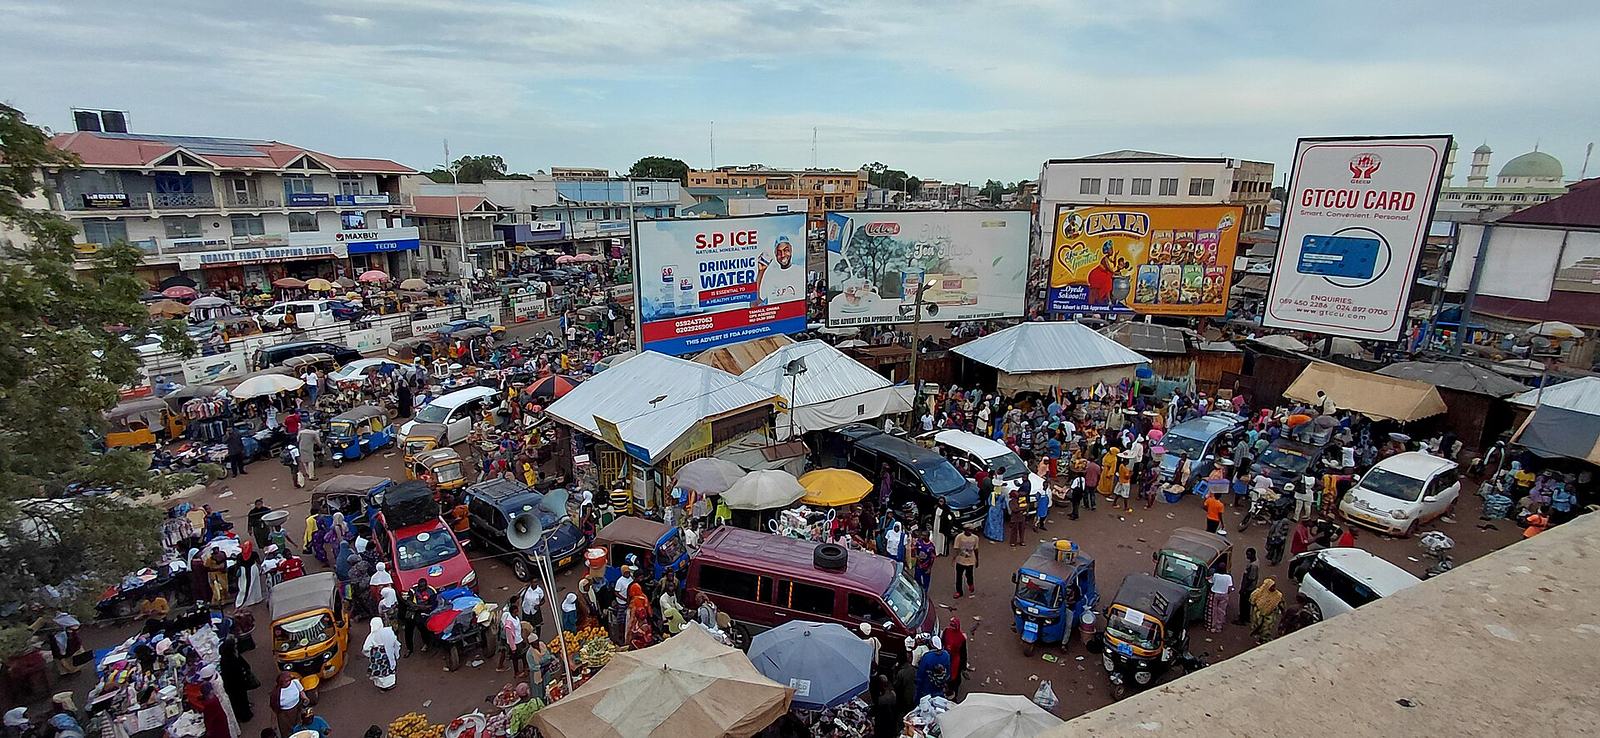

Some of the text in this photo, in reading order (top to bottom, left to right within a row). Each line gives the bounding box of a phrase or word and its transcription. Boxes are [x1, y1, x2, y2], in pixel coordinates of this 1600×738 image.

[1302, 189, 1416, 211] GTCCU CARD
[1088, 214, 1146, 234] ENA PA
[345, 232, 378, 240] MAXBUY
[696, 231, 757, 249] S.P ICE
[200, 246, 332, 262] QUALITY FIRST SHOPPING CENTRE
[700, 257, 755, 272] DRINKING
[700, 270, 755, 289] WATER
[1296, 307, 1366, 320] www.gtccu.com
[700, 335, 722, 343] ADVERT
